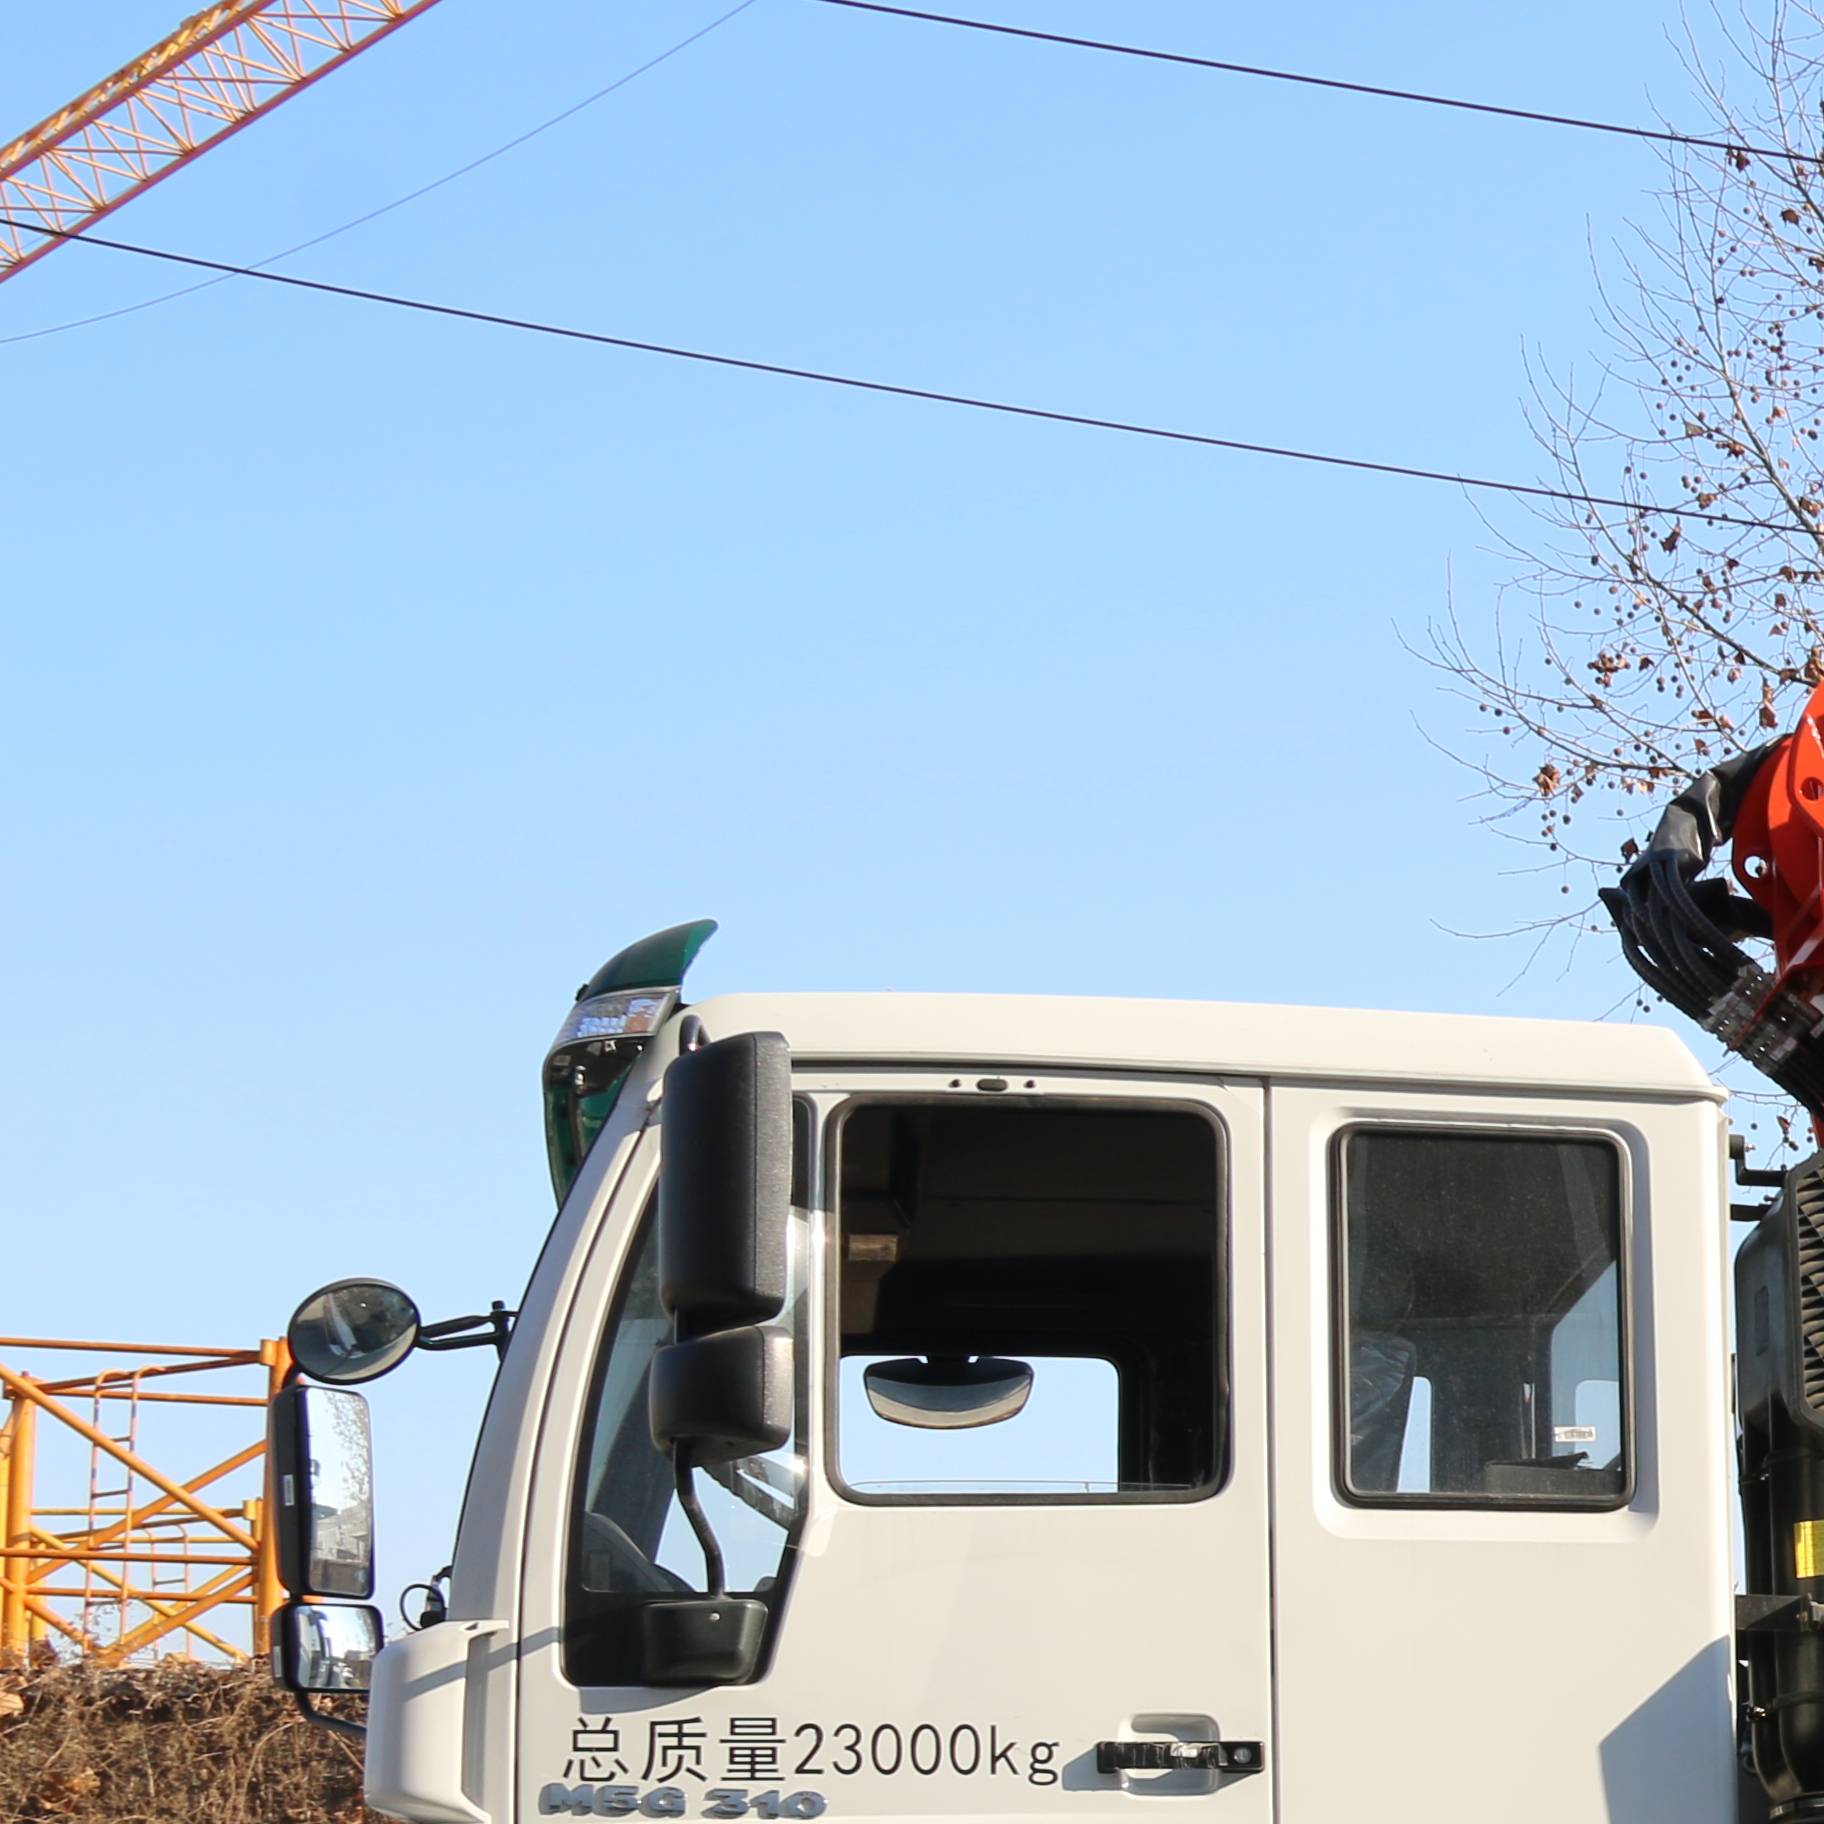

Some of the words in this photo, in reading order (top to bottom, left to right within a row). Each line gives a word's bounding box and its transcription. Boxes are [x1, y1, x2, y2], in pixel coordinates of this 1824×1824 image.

[562, 1715, 1061, 1786] 总质量23000kg
[700, 1786, 829, 1821] 310
